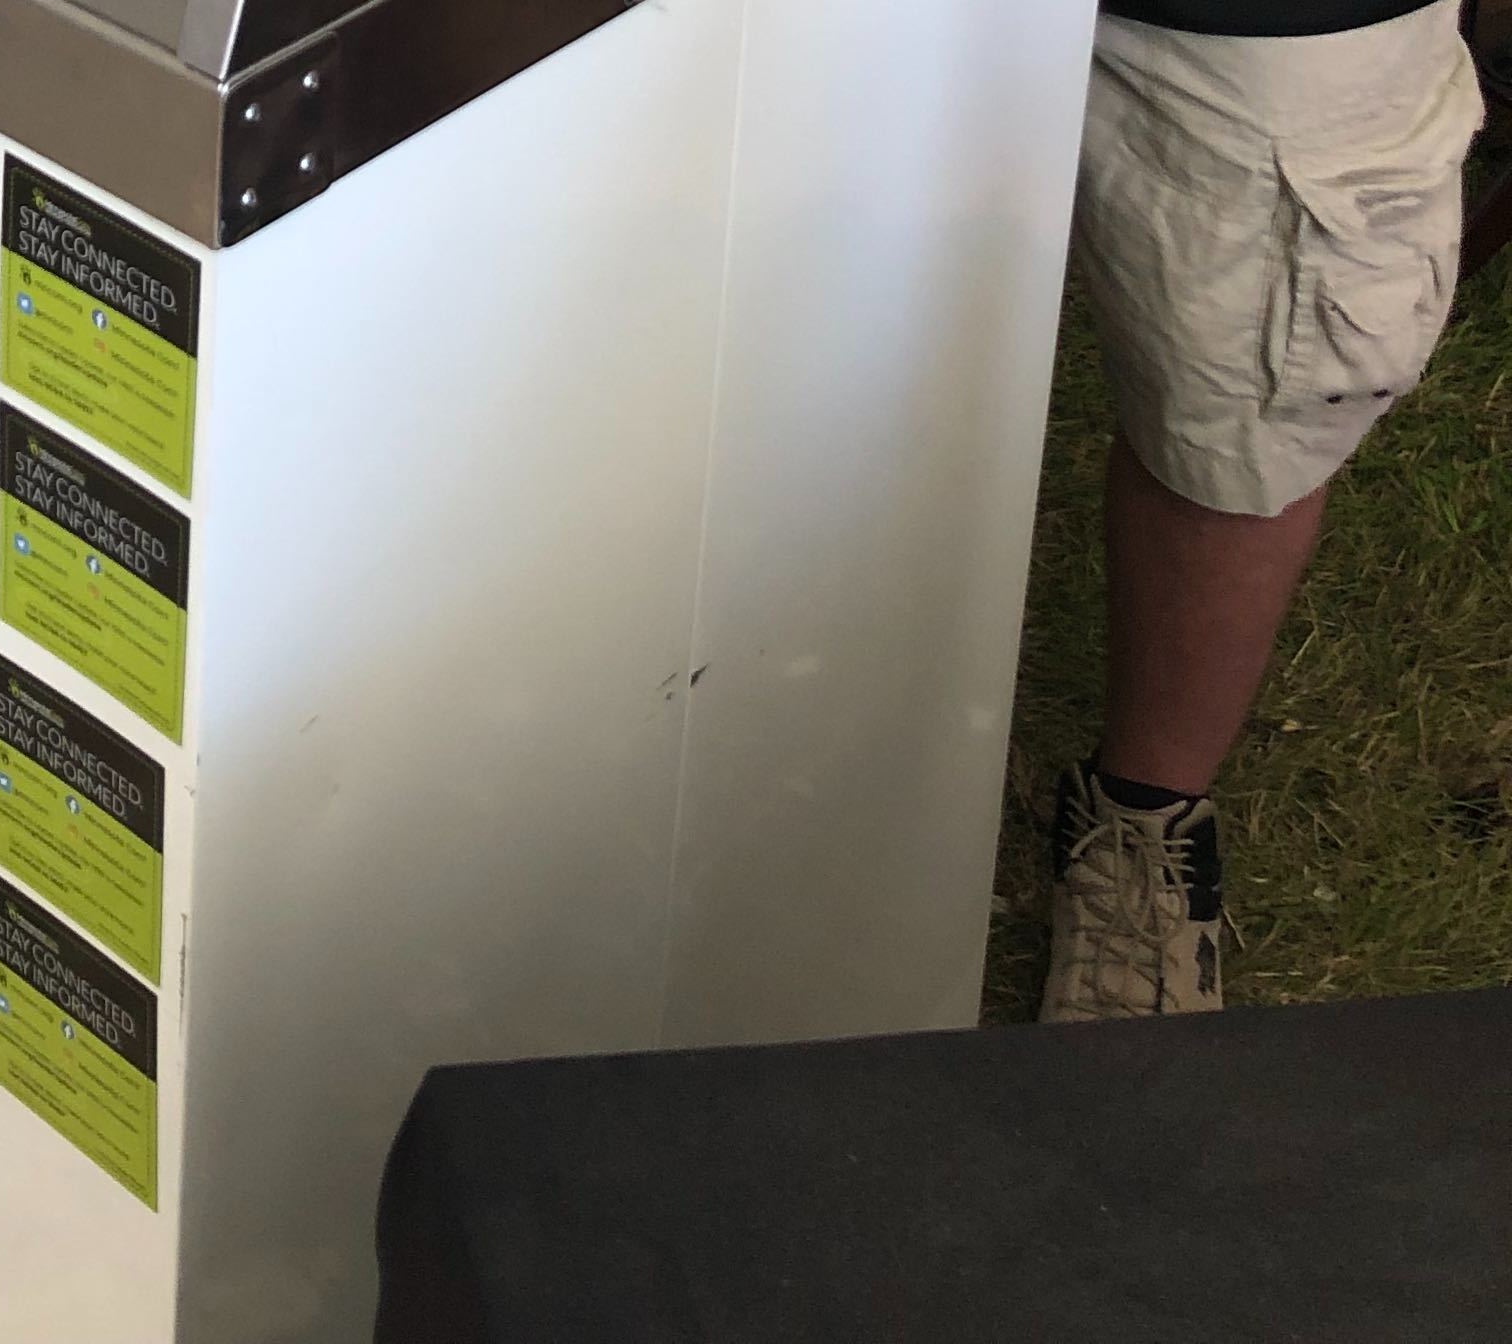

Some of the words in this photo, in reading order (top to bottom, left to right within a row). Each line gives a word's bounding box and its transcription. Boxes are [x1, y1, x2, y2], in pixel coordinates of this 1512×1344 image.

[18, 227, 59, 270] STAY
[61, 251, 159, 331] INFORMED.
[19, 202, 59, 244] STAY
[61, 225, 177, 316] CONNECTED.
[14, 470, 54, 515] STAY
[56, 497, 150, 581] INFORMED.
[15, 446, 54, 490] STAY
[56, 472, 167, 567] CONNECTED.
[36, 715, 144, 811] CONNECTED.
[36, 738, 128, 823] INFORMED.
[32, 938, 137, 1040] CONNECTED.
[32, 962, 122, 1052] INFORMED.
